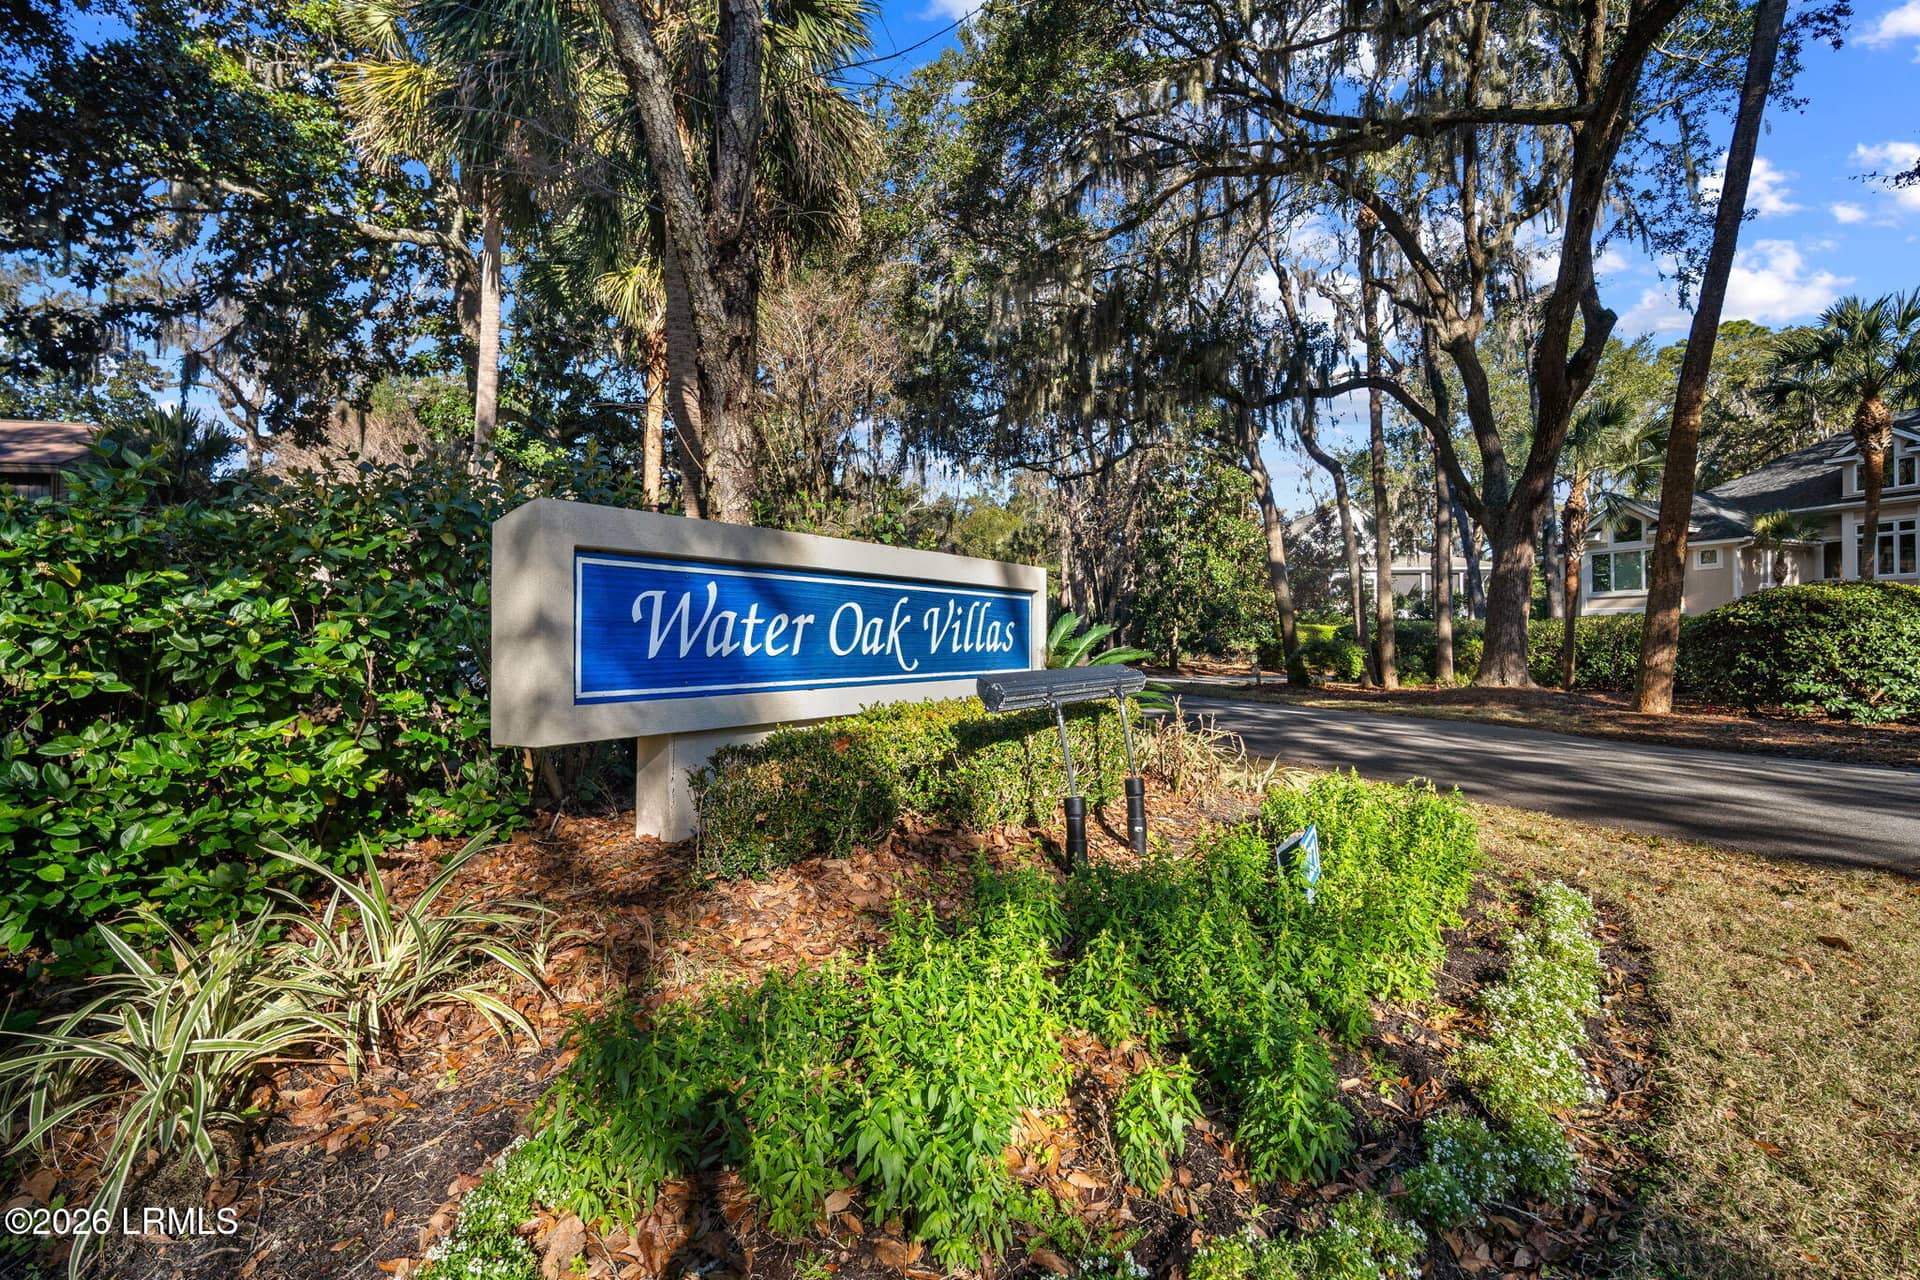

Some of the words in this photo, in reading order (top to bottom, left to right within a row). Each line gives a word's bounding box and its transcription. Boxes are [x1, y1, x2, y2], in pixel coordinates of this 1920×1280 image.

[632, 581, 814, 659] Water
[829, 597, 918, 671] Oak
[923, 600, 1015, 654] Villas
